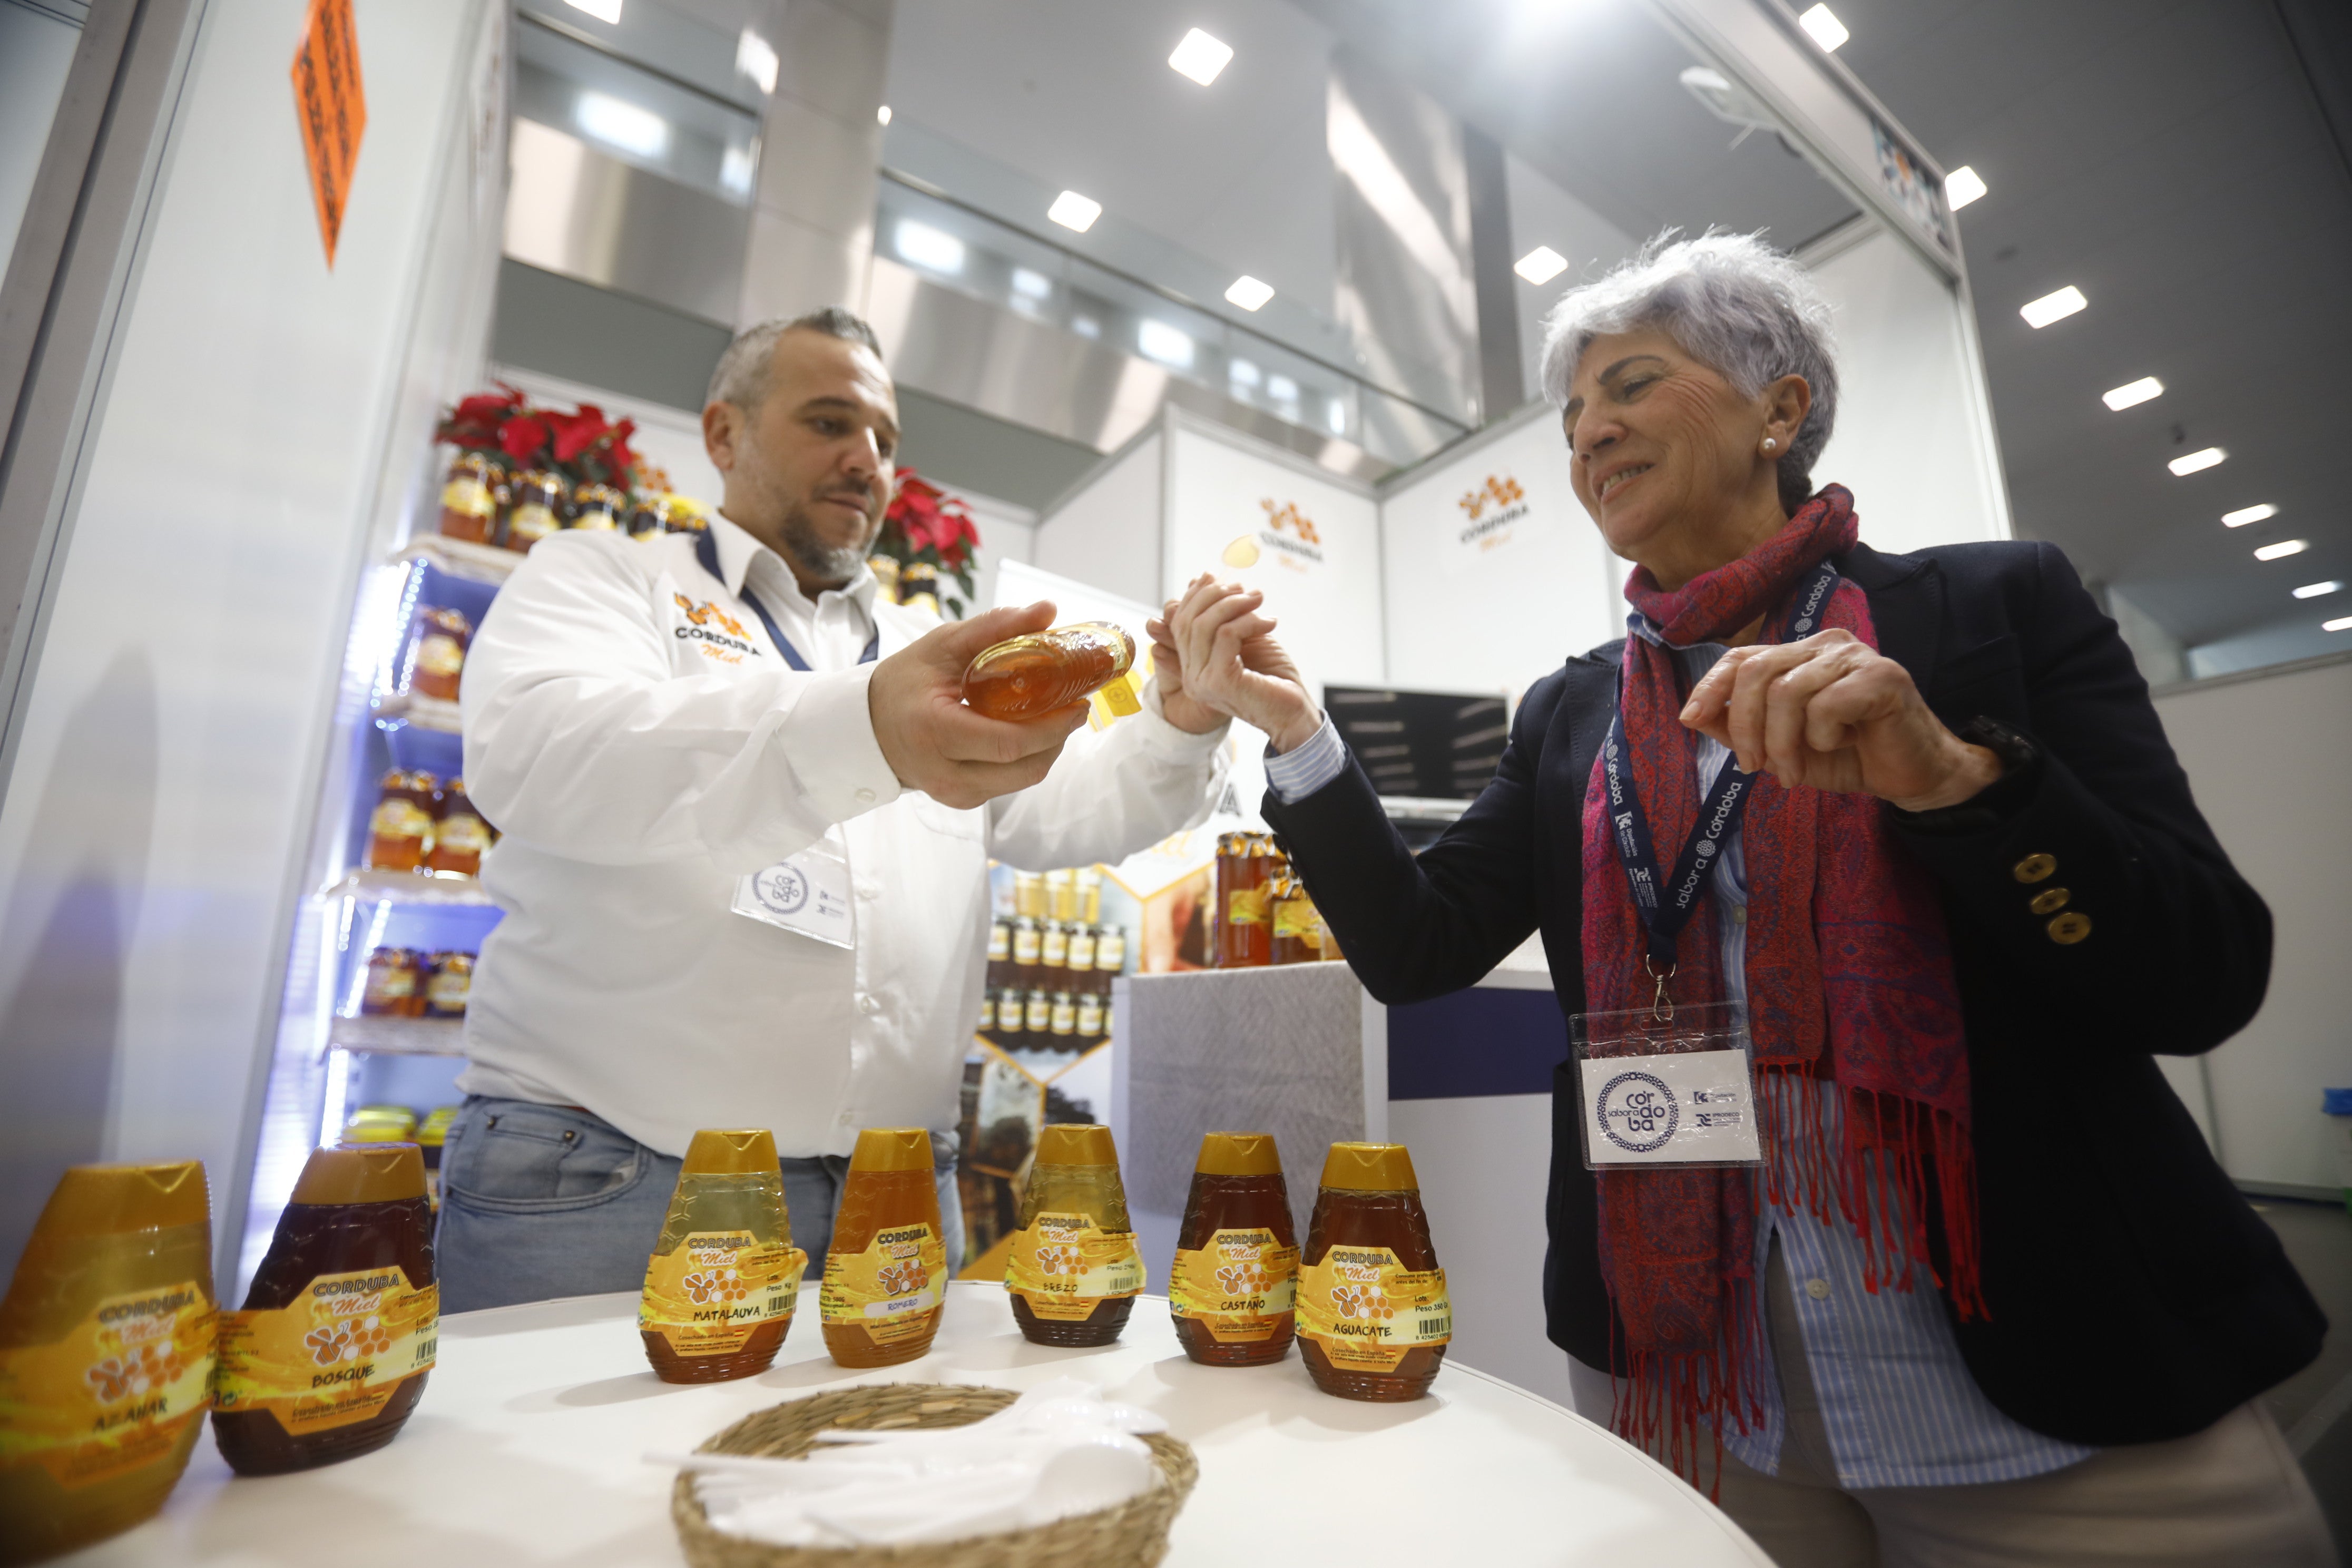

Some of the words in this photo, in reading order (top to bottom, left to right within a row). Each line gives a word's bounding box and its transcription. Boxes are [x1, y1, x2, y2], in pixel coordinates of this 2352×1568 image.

[675, 626, 762, 656] CORDUBA
[1676, 869, 1700, 909] sabor
[1695, 858, 1708, 870] a
[1706, 782, 1743, 839] Córdoba
[1038, 1217, 1090, 1228] CORDUBA
[877, 1228, 927, 1244] CORDUBA
[1050, 1230, 1077, 1241] Miel
[1217, 1233, 1271, 1245] CORDUBA
[689, 1237, 751, 1249] CORDUBA
[891, 1243, 918, 1258] Miel
[1231, 1247, 1259, 1259] Miel
[703, 1252, 735, 1265] Miel
[1332, 1251, 1393, 1265] CORDUBA
[1346, 1267, 1378, 1280] Miel
[313, 1273, 400, 1297] CORDUBA
[1043, 1282, 1078, 1292] BREZO
[99, 1290, 195, 1323] CORDUBA
[333, 1294, 380, 1315] Miel
[887, 1298, 918, 1311] ROMERO
[1221, 1296, 1265, 1310] CASTAÑO
[694, 1306, 760, 1321] MATALAUVA
[415, 1325, 432, 1336] Peso
[1334, 1323, 1393, 1337] AGUACATE
[312, 1364, 376, 1389] BOSQUE
